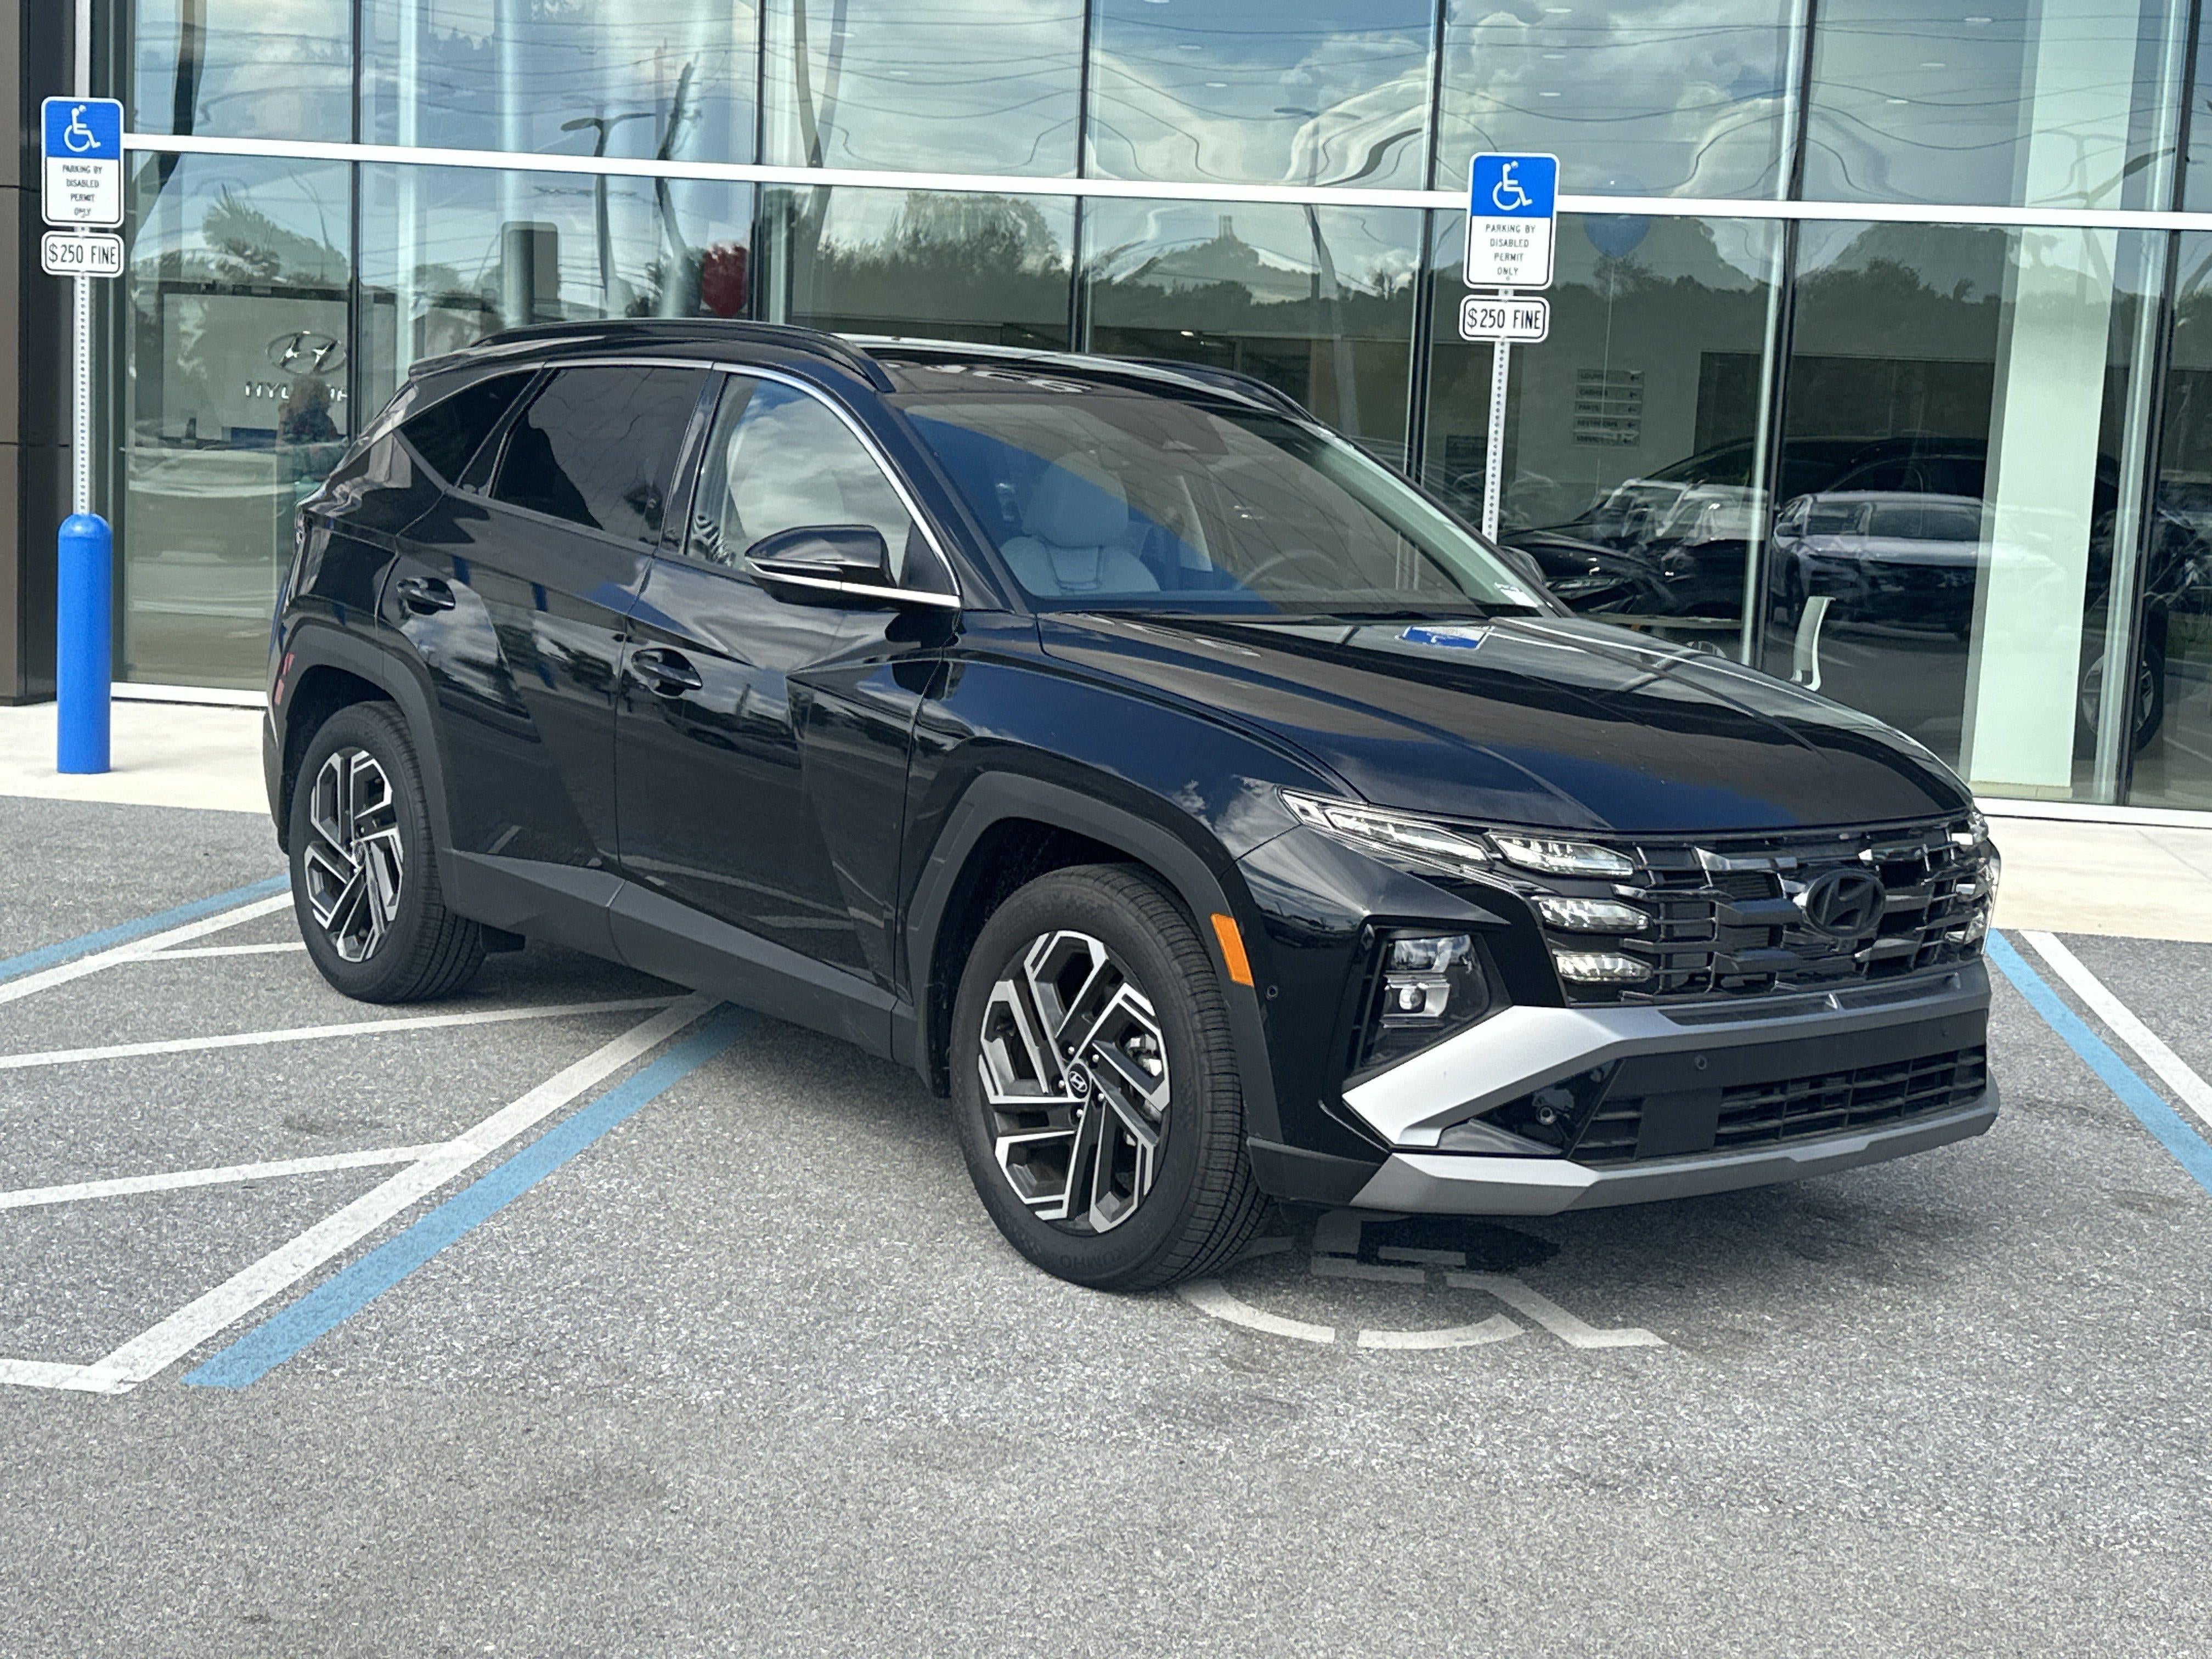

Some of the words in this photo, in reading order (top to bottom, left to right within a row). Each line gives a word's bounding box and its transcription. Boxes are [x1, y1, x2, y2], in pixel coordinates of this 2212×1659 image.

[63, 165, 91, 174] PARKING
[93, 166, 103, 174] BY
[66, 179, 99, 188] DISABLED
[70, 193, 95, 202] PERMIT
[1486, 224, 1521, 233] PARKING
[1525, 224, 1536, 234] BY
[1490, 238, 1529, 247] DISABLED
[48, 242, 83, 263] $250
[91, 245, 116, 264] FINE
[1494, 252, 1523, 262] PERMIT
[1497, 267, 1519, 275] ONLY
[1467, 307, 1505, 329] $250
[1513, 309, 1541, 330] FINE
